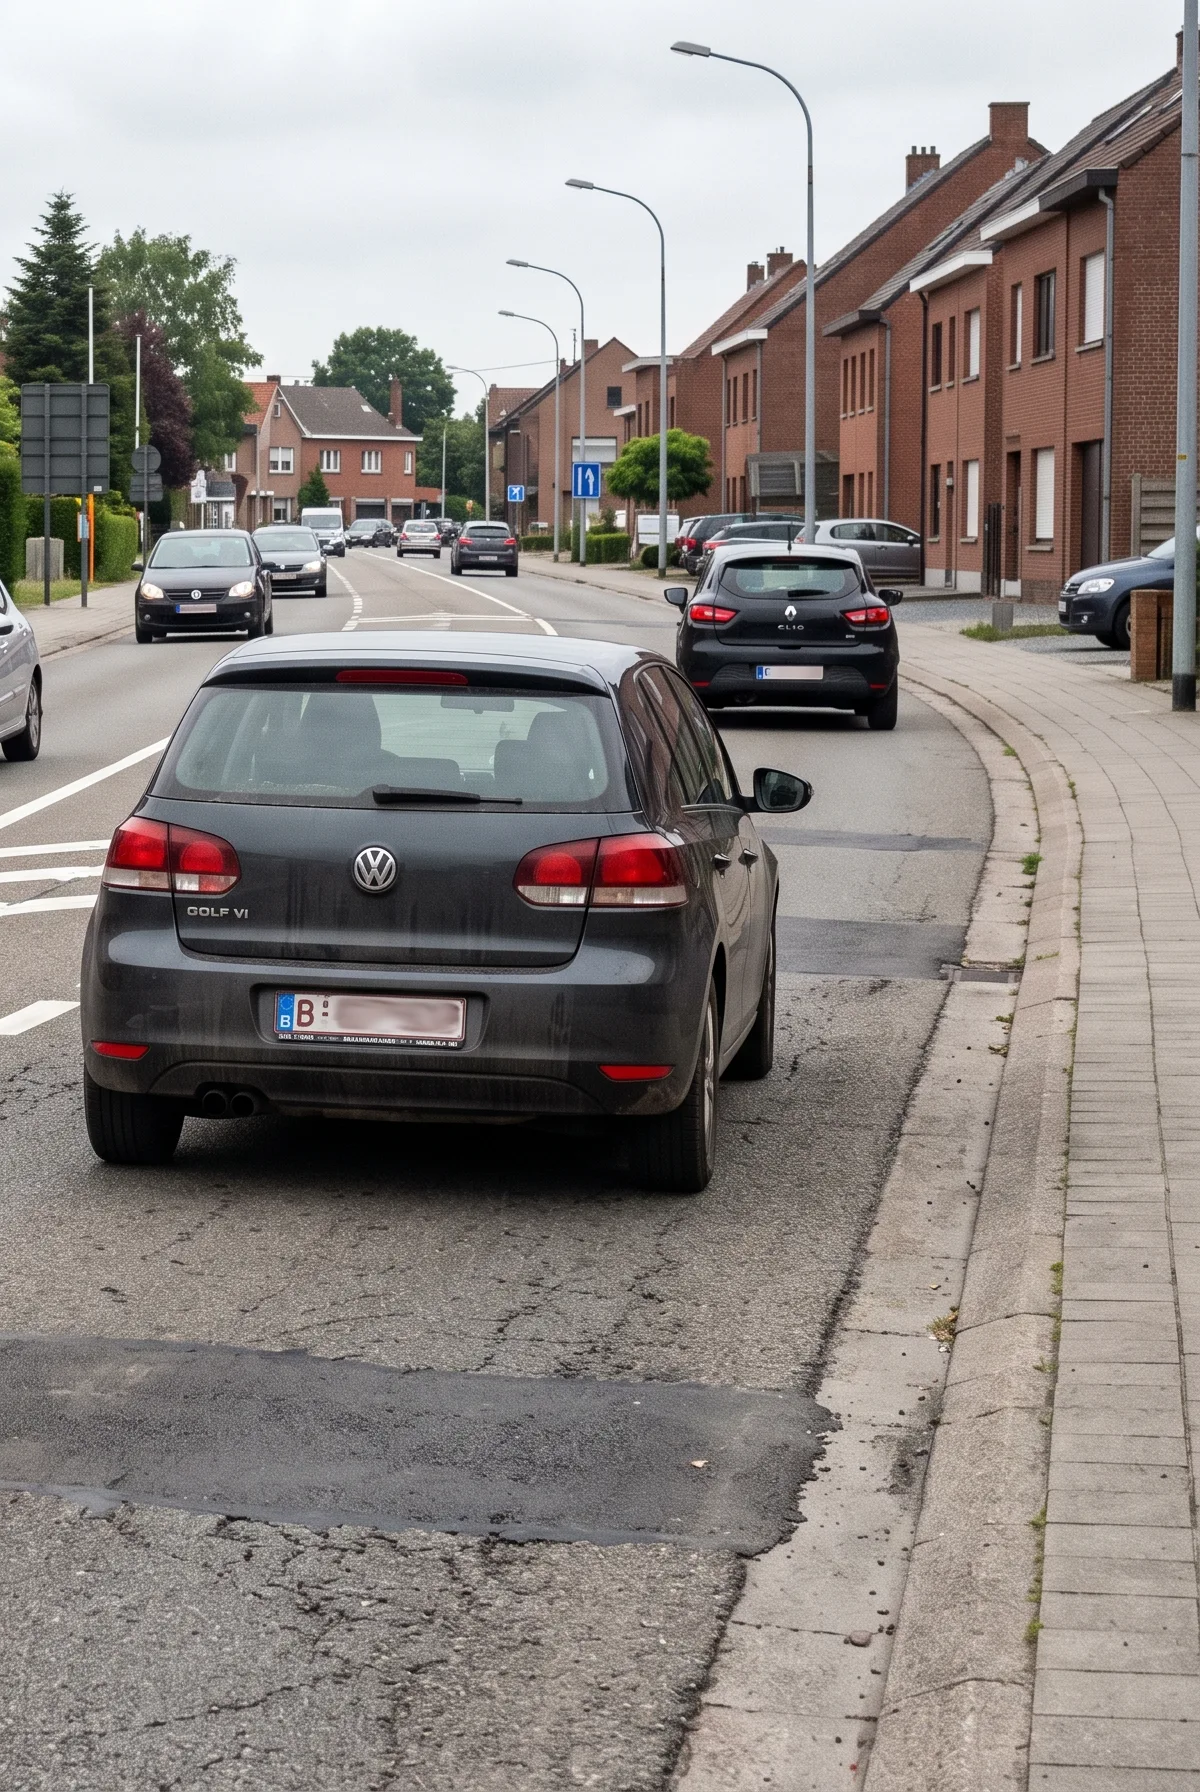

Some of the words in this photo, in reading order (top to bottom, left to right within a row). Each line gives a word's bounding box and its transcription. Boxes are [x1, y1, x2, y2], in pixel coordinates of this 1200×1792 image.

[354, 847, 397, 891] VW
[187, 906, 230, 917] GOLF
[233, 908, 249, 919] VI
[280, 1014, 291, 1028] B
